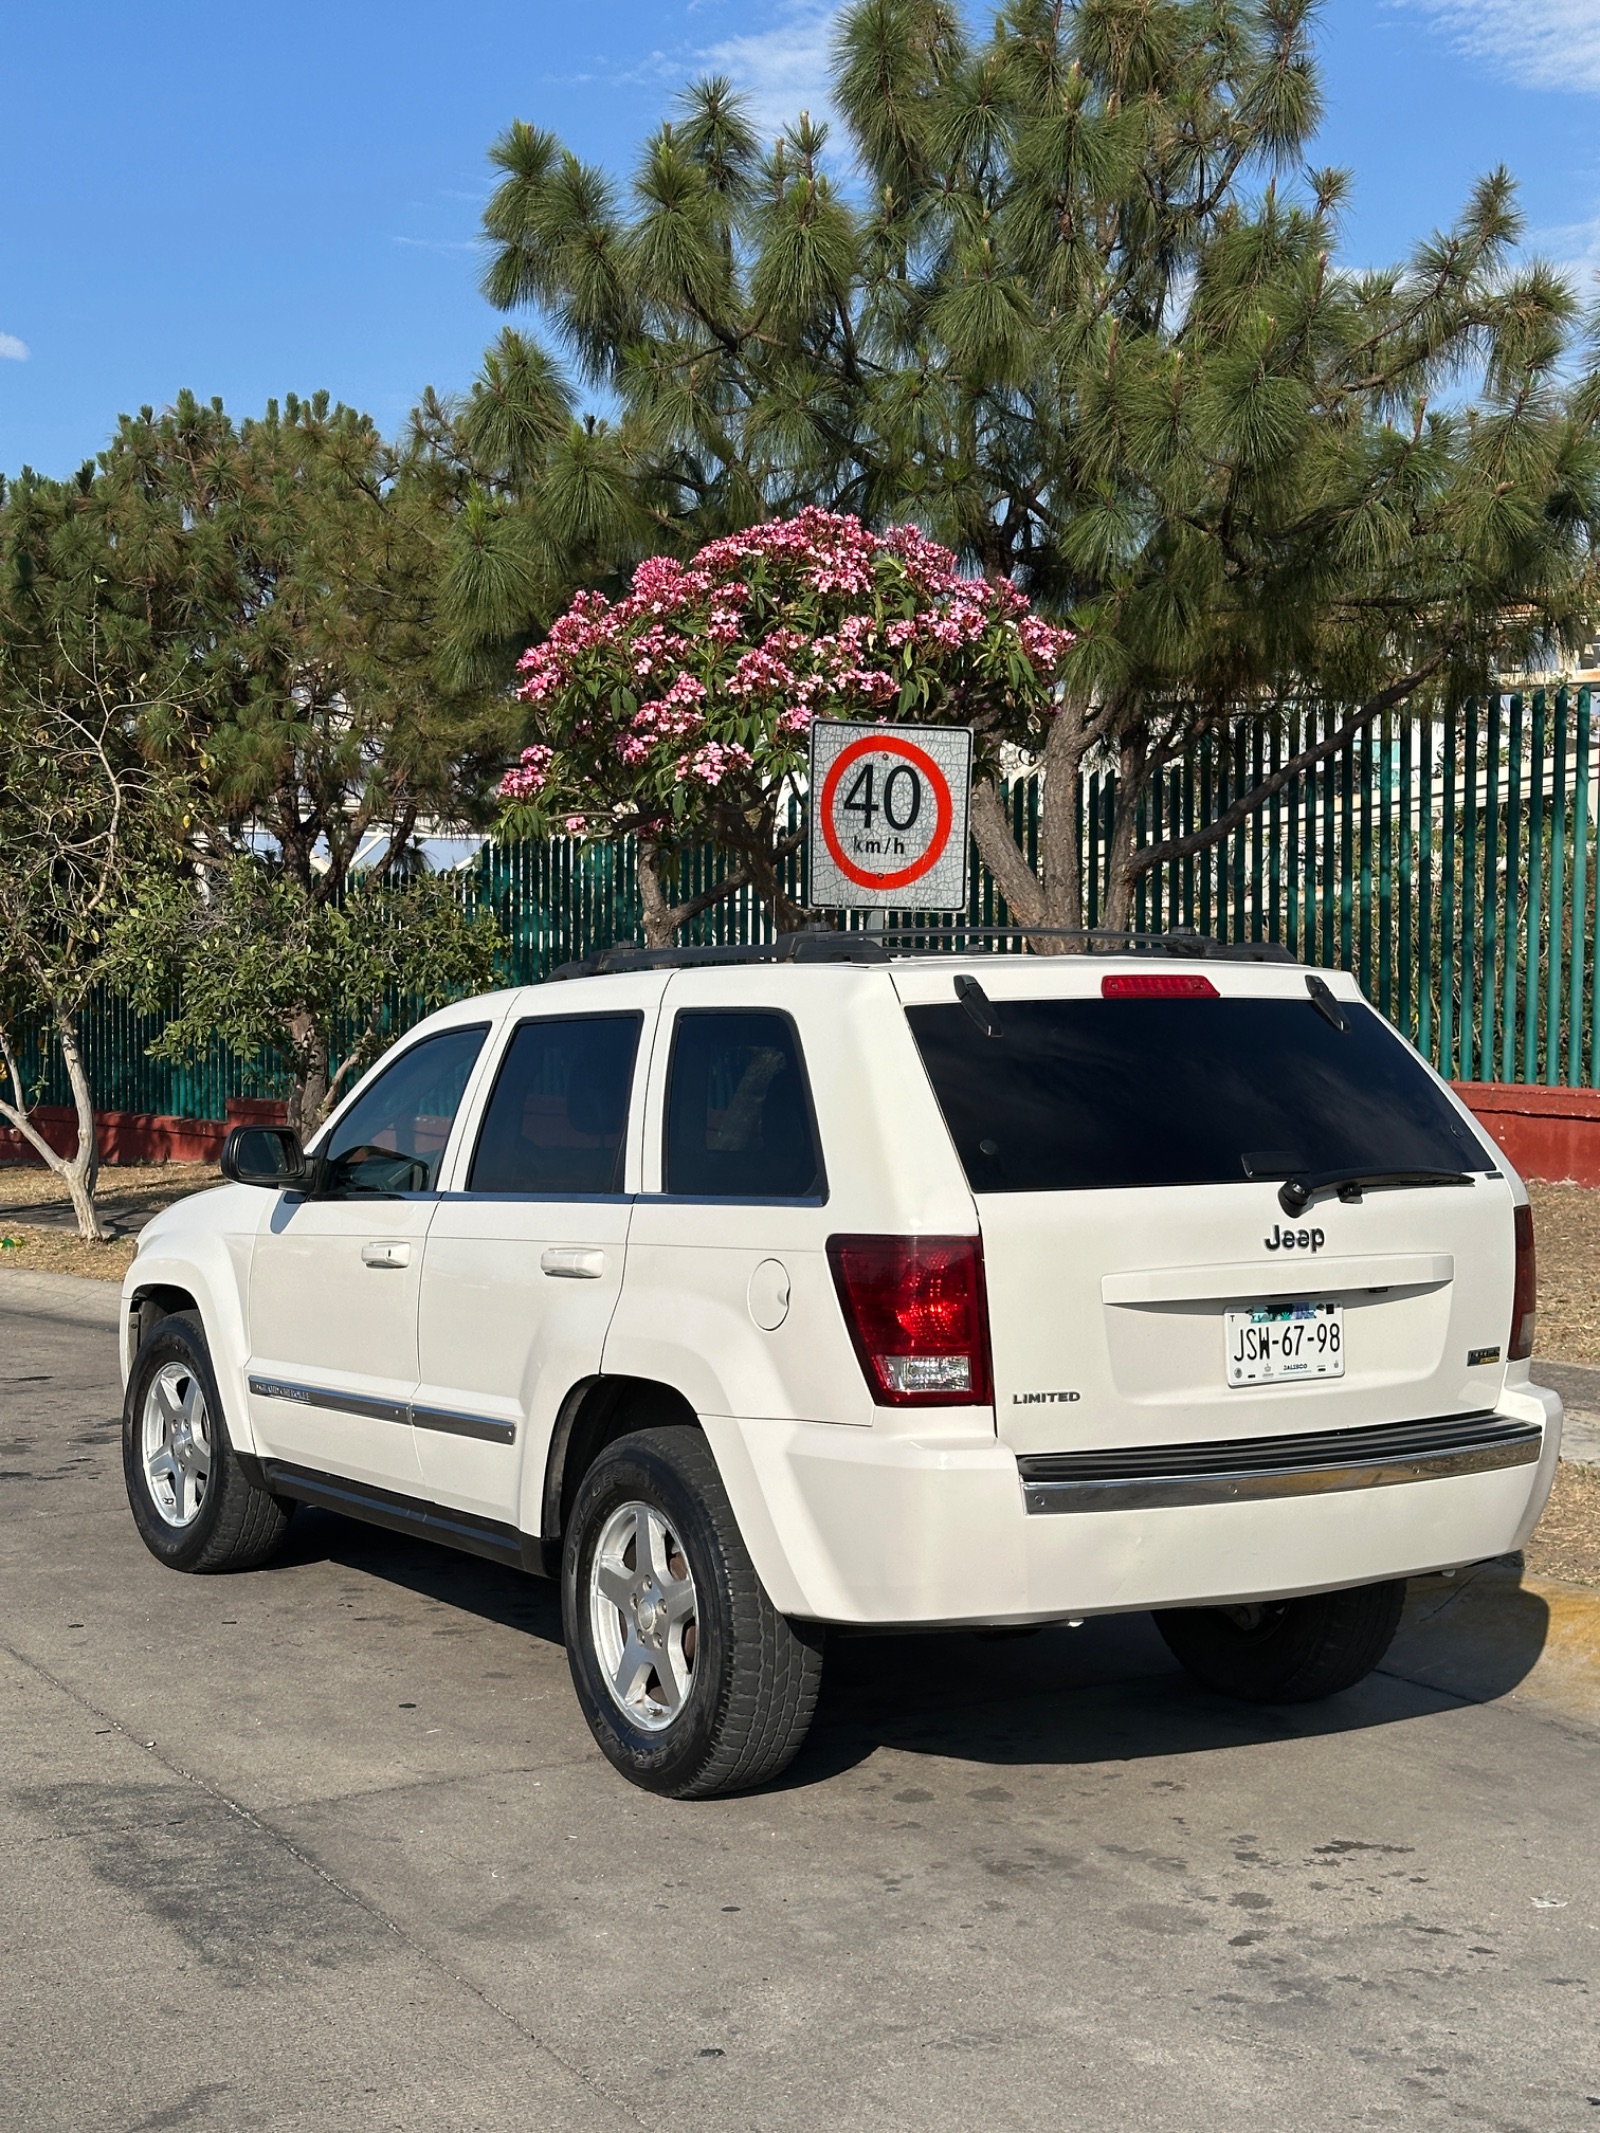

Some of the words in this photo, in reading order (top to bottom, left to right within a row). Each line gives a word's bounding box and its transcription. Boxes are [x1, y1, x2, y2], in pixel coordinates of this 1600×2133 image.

[844, 764, 921, 831] 40
[854, 837, 905, 855] km/h
[1264, 1224, 1325, 1254] Jeep
[1234, 1323, 1341, 1362] JSW-67-98
[1283, 1363, 1308, 1371] JALISCO
[1013, 1391, 1081, 1405] LIMITED
